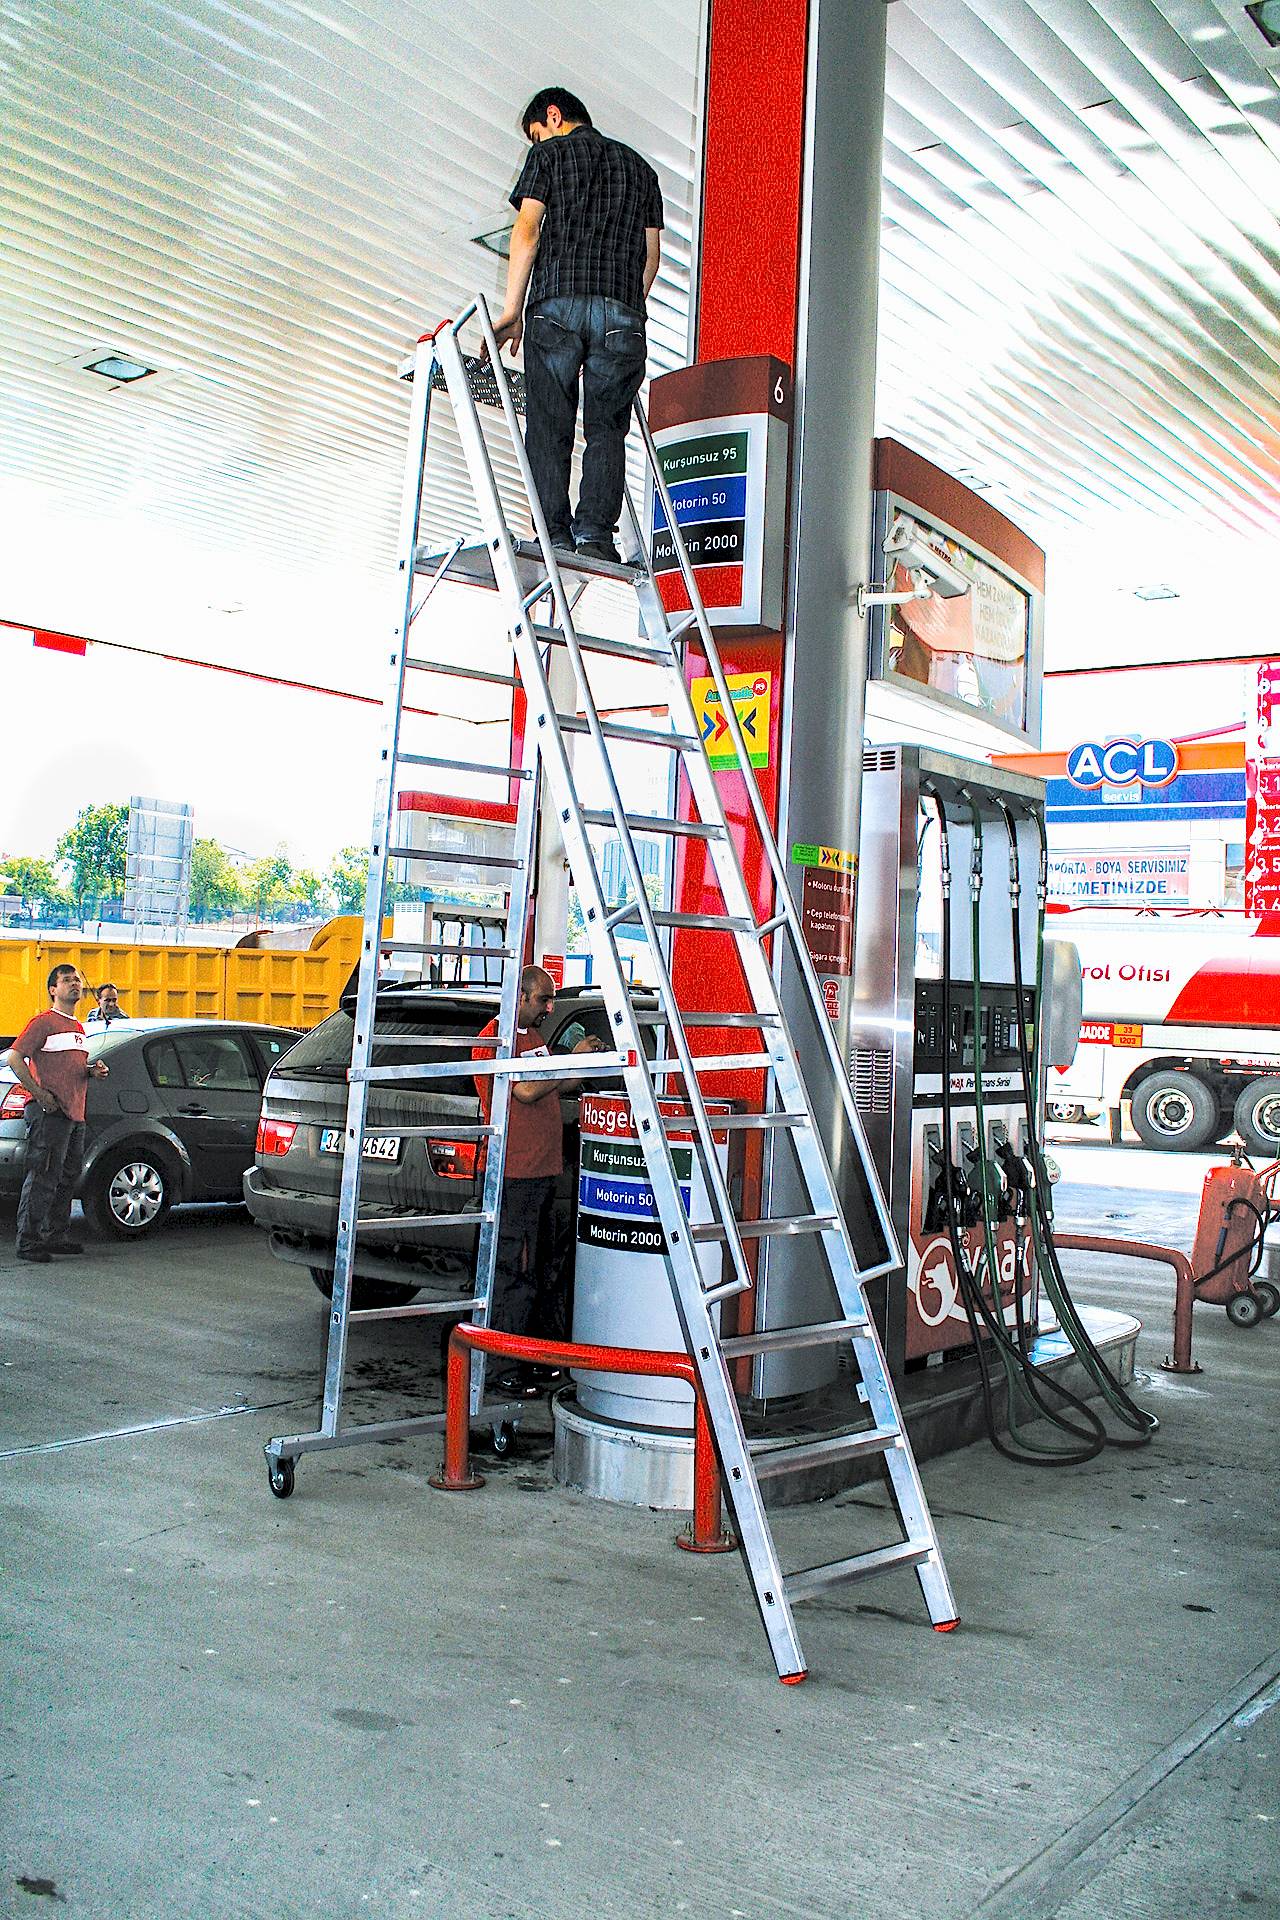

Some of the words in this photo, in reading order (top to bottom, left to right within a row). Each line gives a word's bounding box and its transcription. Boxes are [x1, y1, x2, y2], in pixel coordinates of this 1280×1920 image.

[774, 376, 785, 404] 6
[663, 452, 719, 472] Kurşunsuz
[722, 447, 737, 461] 95
[712, 492, 727, 505] 50
[655, 539, 700, 559] Motrin
[704, 534, 738, 551] 2000
[1072, 744, 1168, 778] ACL
[1095, 861, 1122, 875] BOYA
[810, 909, 823, 919] Cep
[1123, 1026, 1133, 1034] 33
[1120, 1036, 1136, 1045] 1203
[326, 1132, 341, 1151] 34
[363, 1137, 396, 1157] 4642
[593, 1149, 648, 1167] Kurşunsuz
[596, 1187, 635, 1206] Motorin
[638, 1193, 654, 1207] 50
[590, 1225, 628, 1244] Motorin
[630, 1231, 662, 1247] 2000
